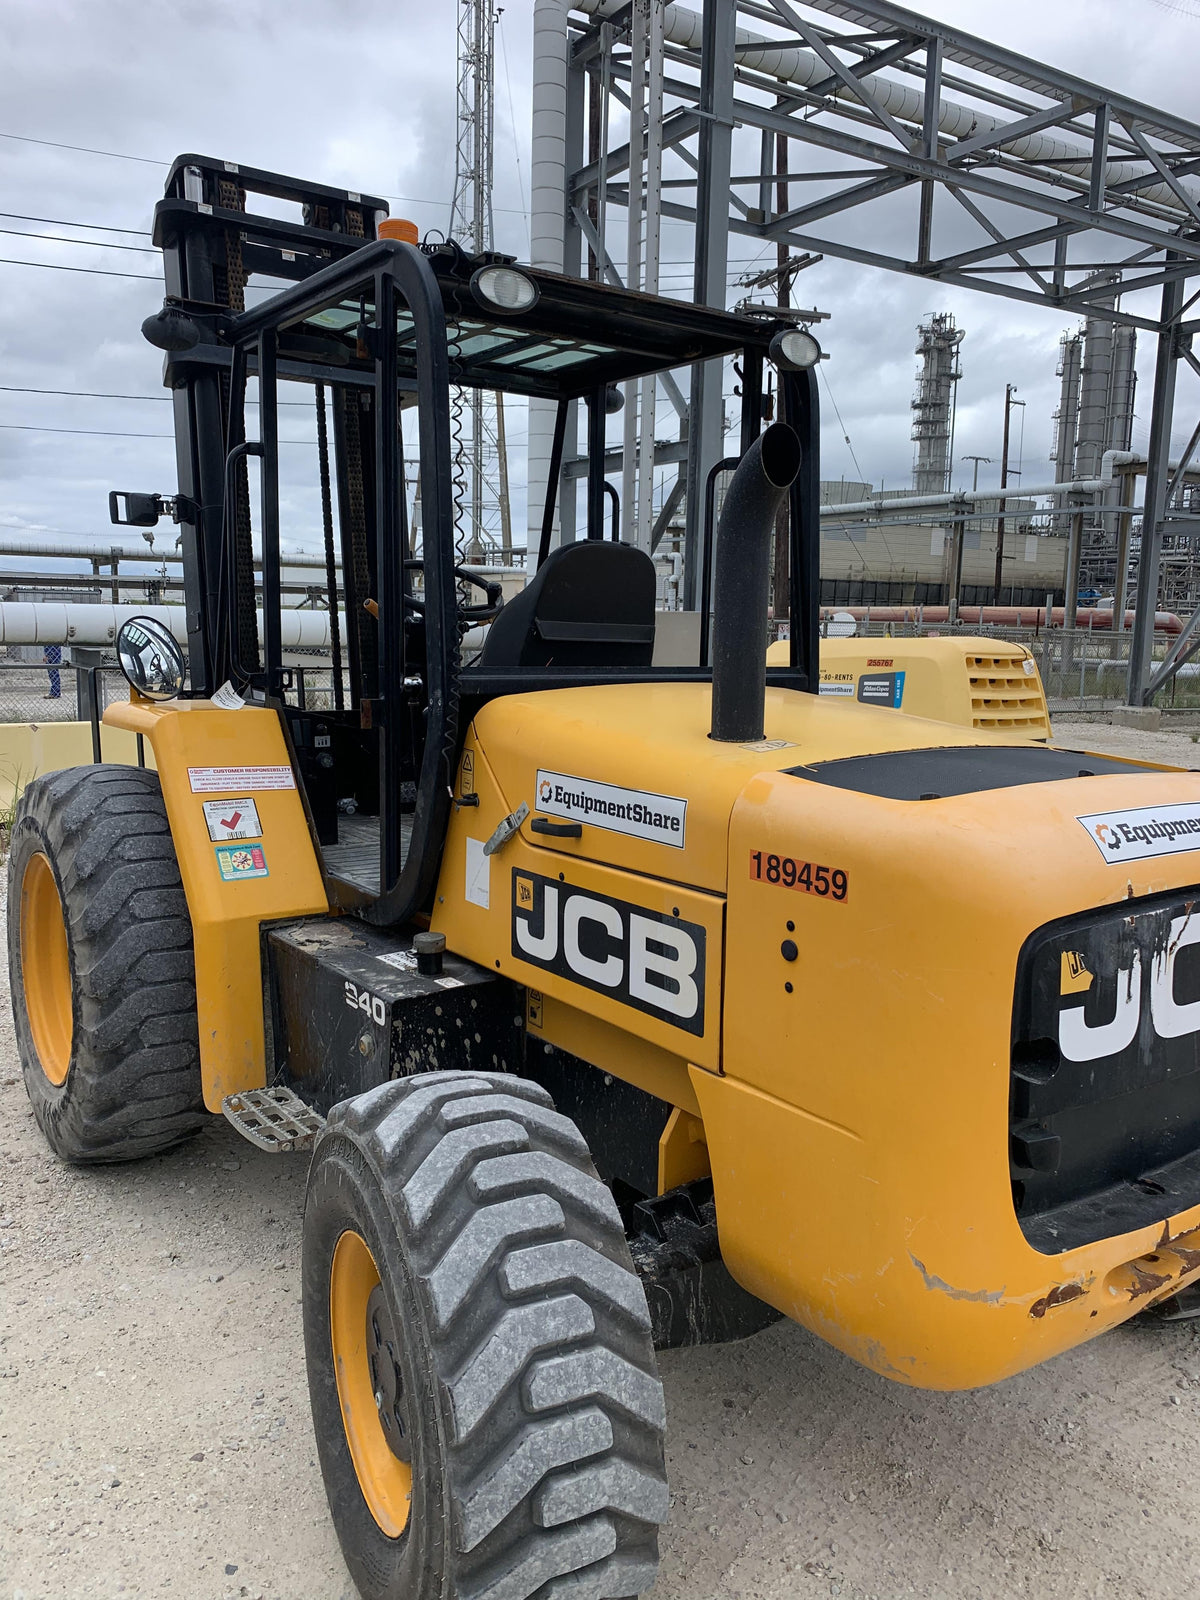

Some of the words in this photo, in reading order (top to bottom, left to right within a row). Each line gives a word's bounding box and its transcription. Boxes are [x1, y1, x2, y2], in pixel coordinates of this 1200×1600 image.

[554, 786, 680, 831] EquipmentShare
[752, 851, 848, 900] 189459
[516, 885, 698, 1018] JCB
